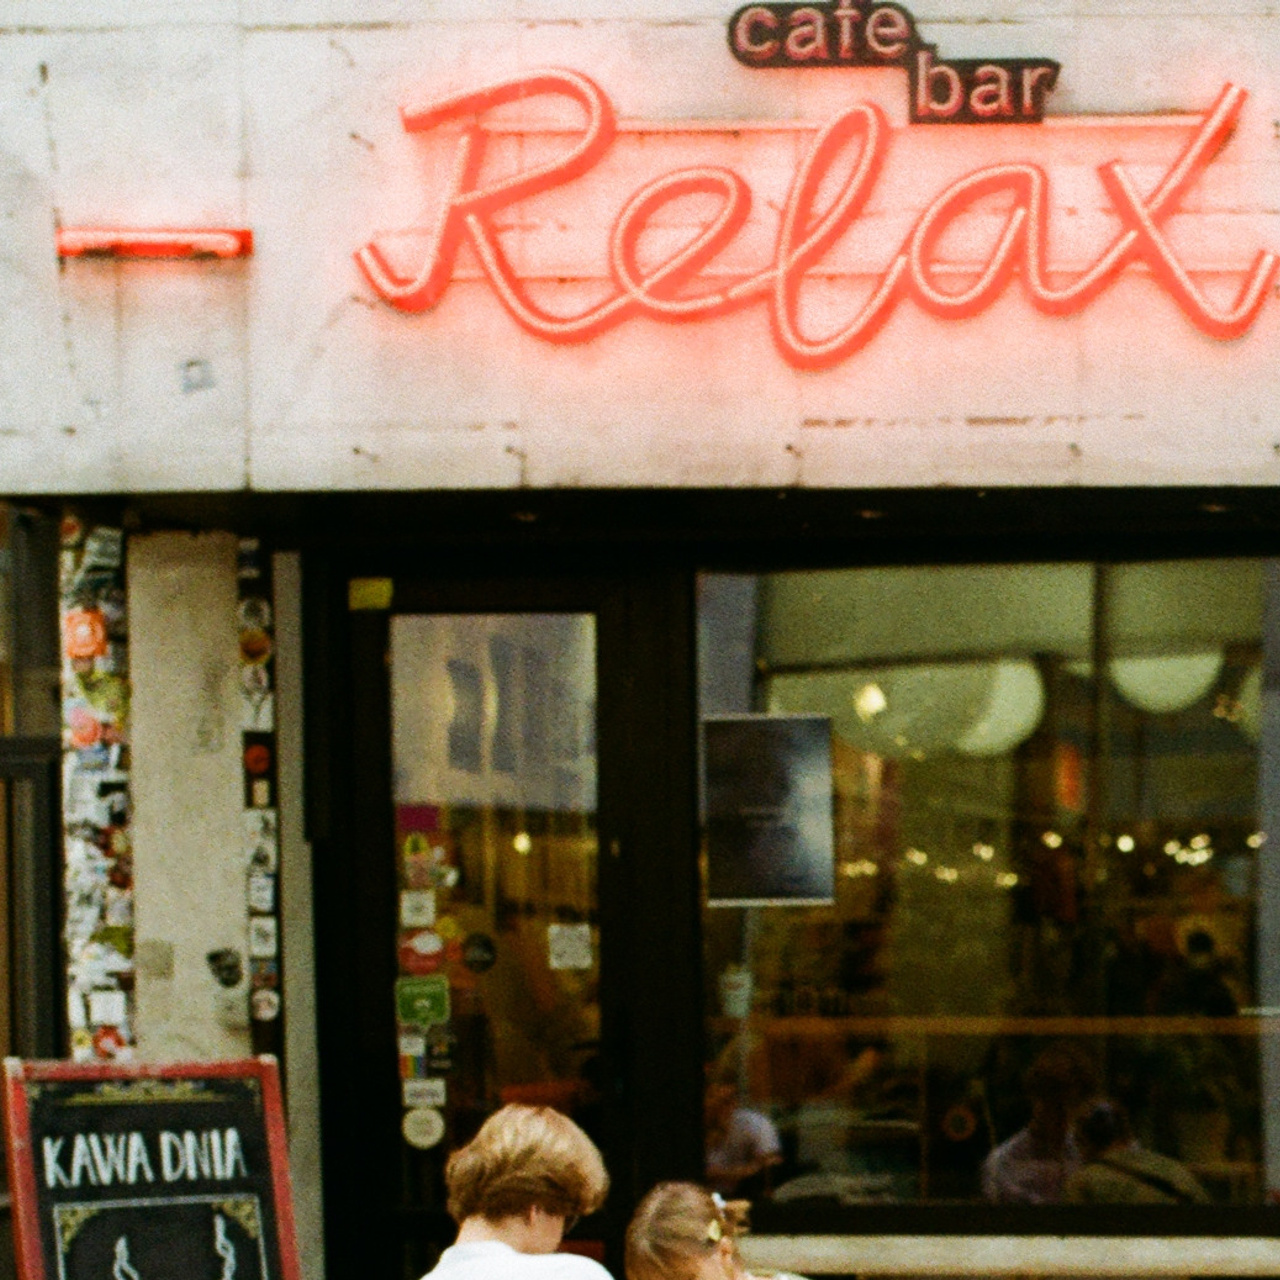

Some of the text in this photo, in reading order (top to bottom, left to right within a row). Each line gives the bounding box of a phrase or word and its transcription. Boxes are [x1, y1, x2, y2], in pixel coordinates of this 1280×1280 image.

[915, 51, 1054, 117] bar
[42, 1126, 248, 1188] KAWA DNIA
